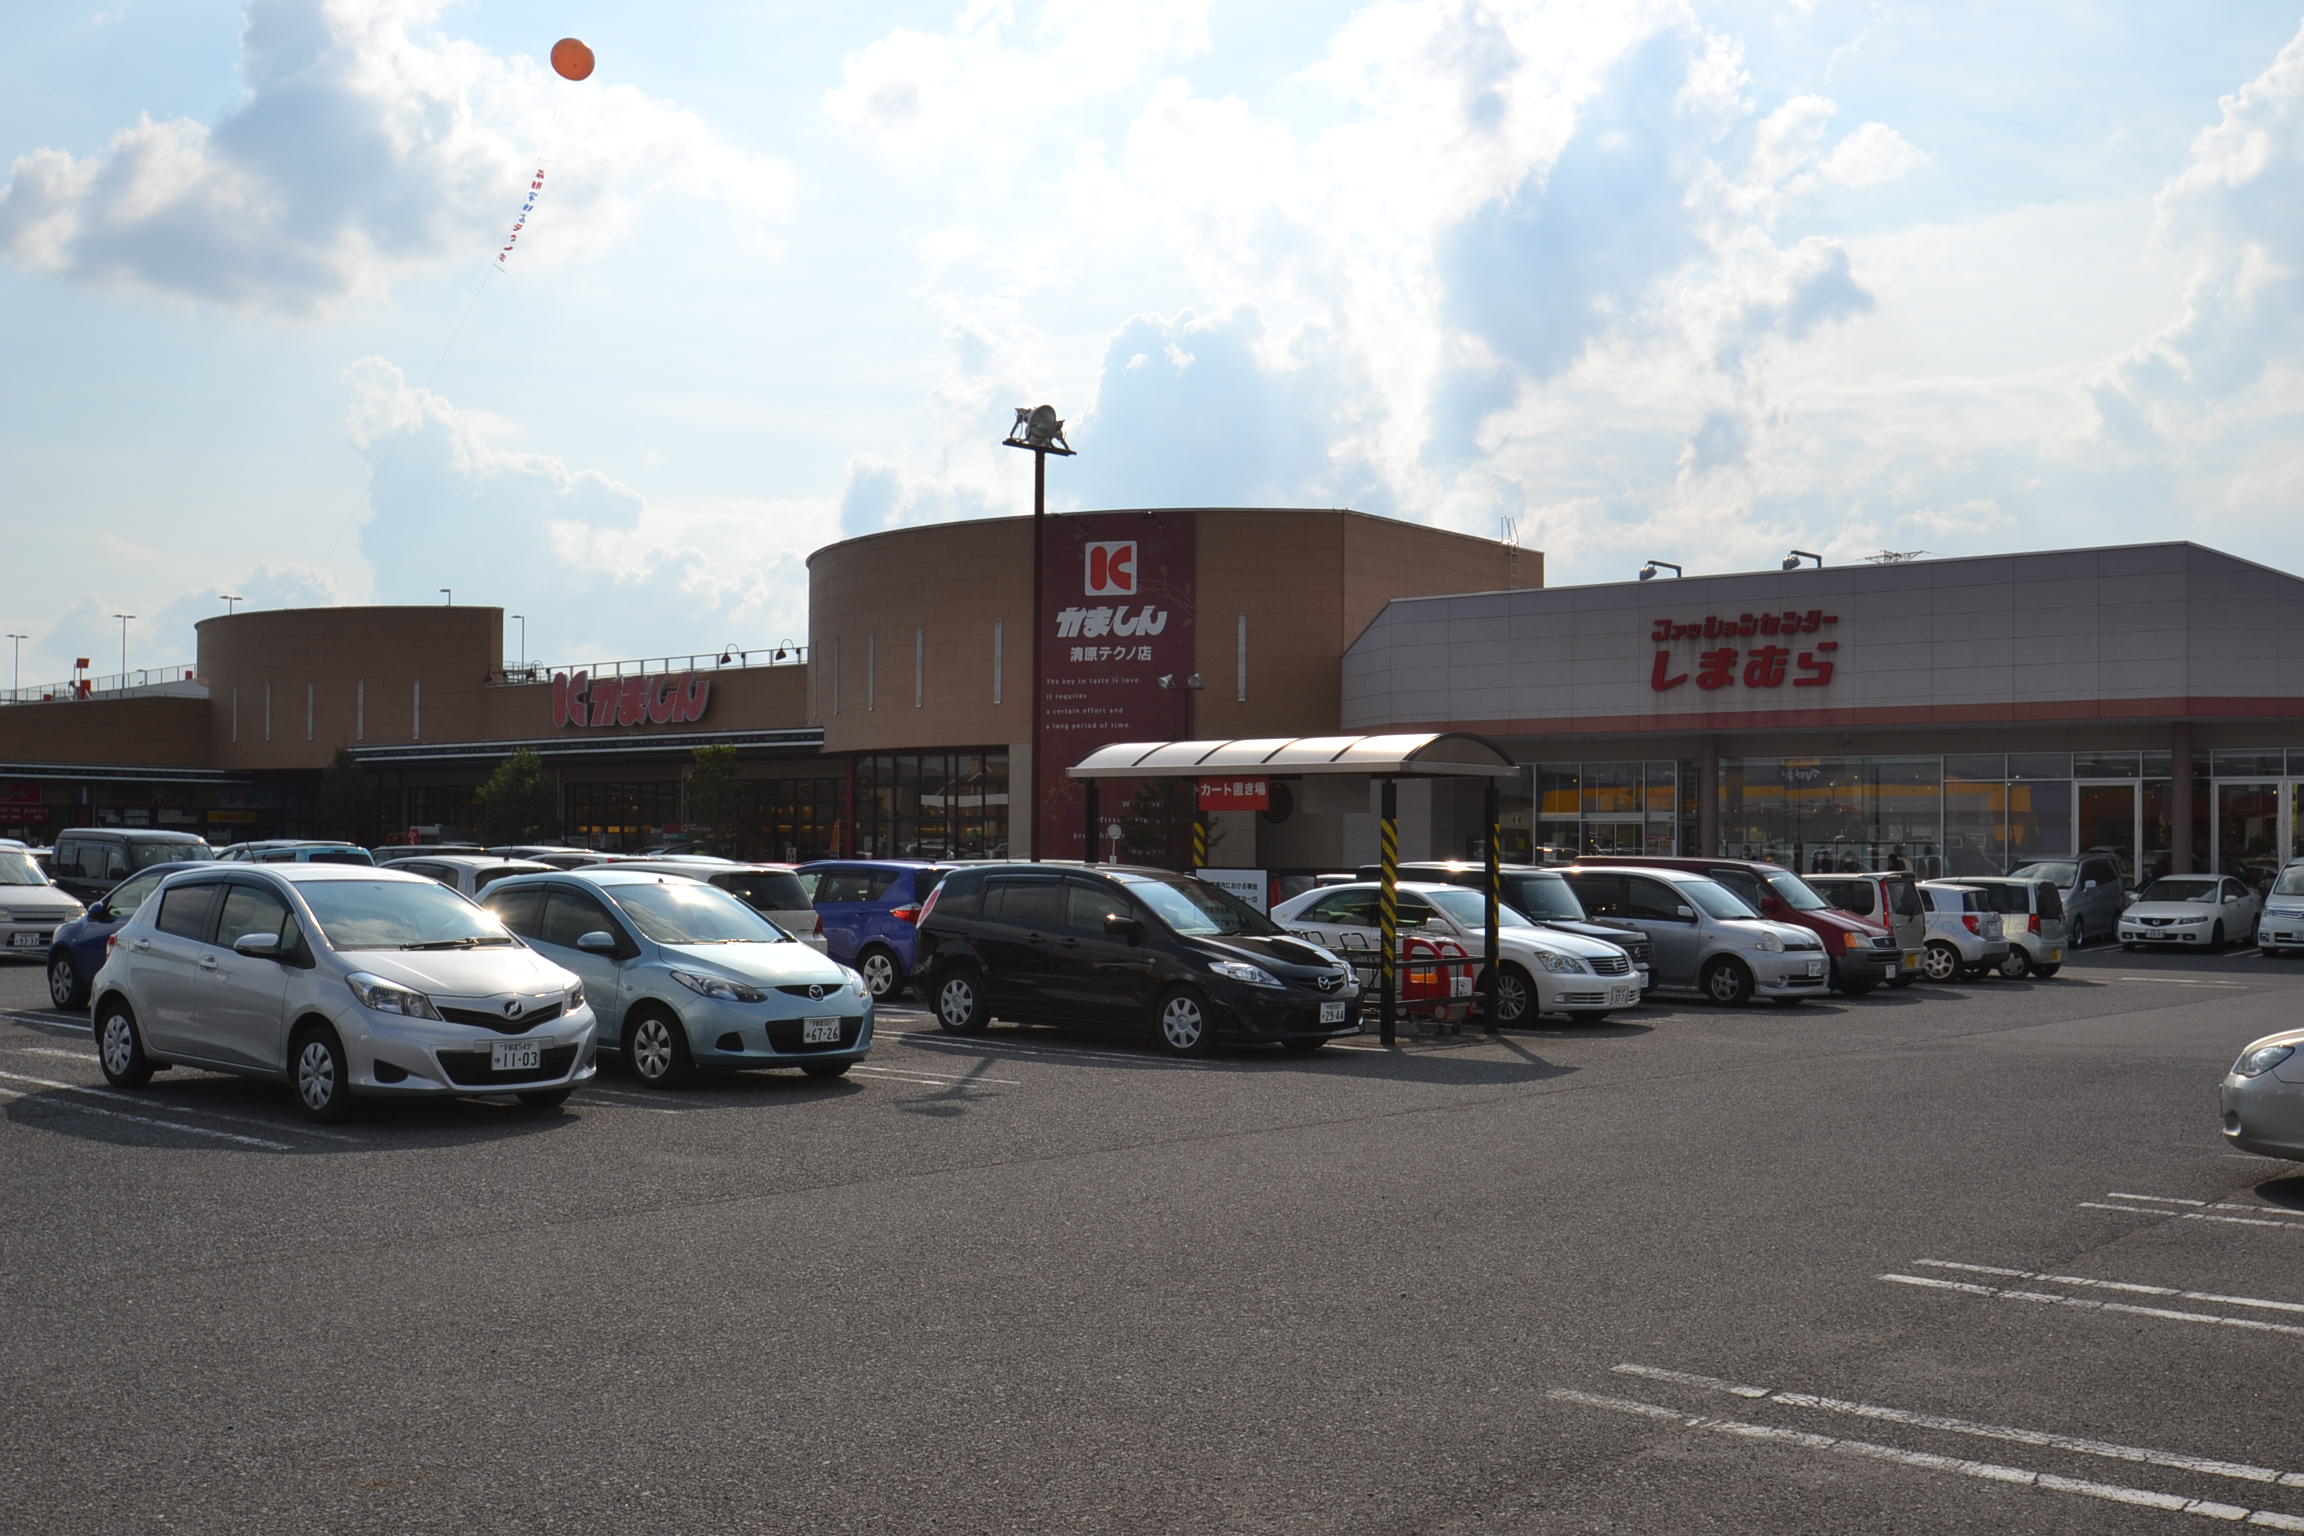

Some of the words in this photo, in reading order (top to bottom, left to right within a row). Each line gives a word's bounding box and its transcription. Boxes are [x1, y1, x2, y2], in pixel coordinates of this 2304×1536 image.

[1055, 604, 1168, 638] かましん
[1651, 609, 1839, 642] ファッションセンター
[1069, 646, 1153, 663] 清原テクノ店
[1651, 642, 1838, 691] しまむら
[1052, 722, 1068, 730] long
[1201, 781, 1266, 796] カート置き場
[811, 1026, 838, 1041] 67-26
[503, 1052, 538, 1068] 11-03
